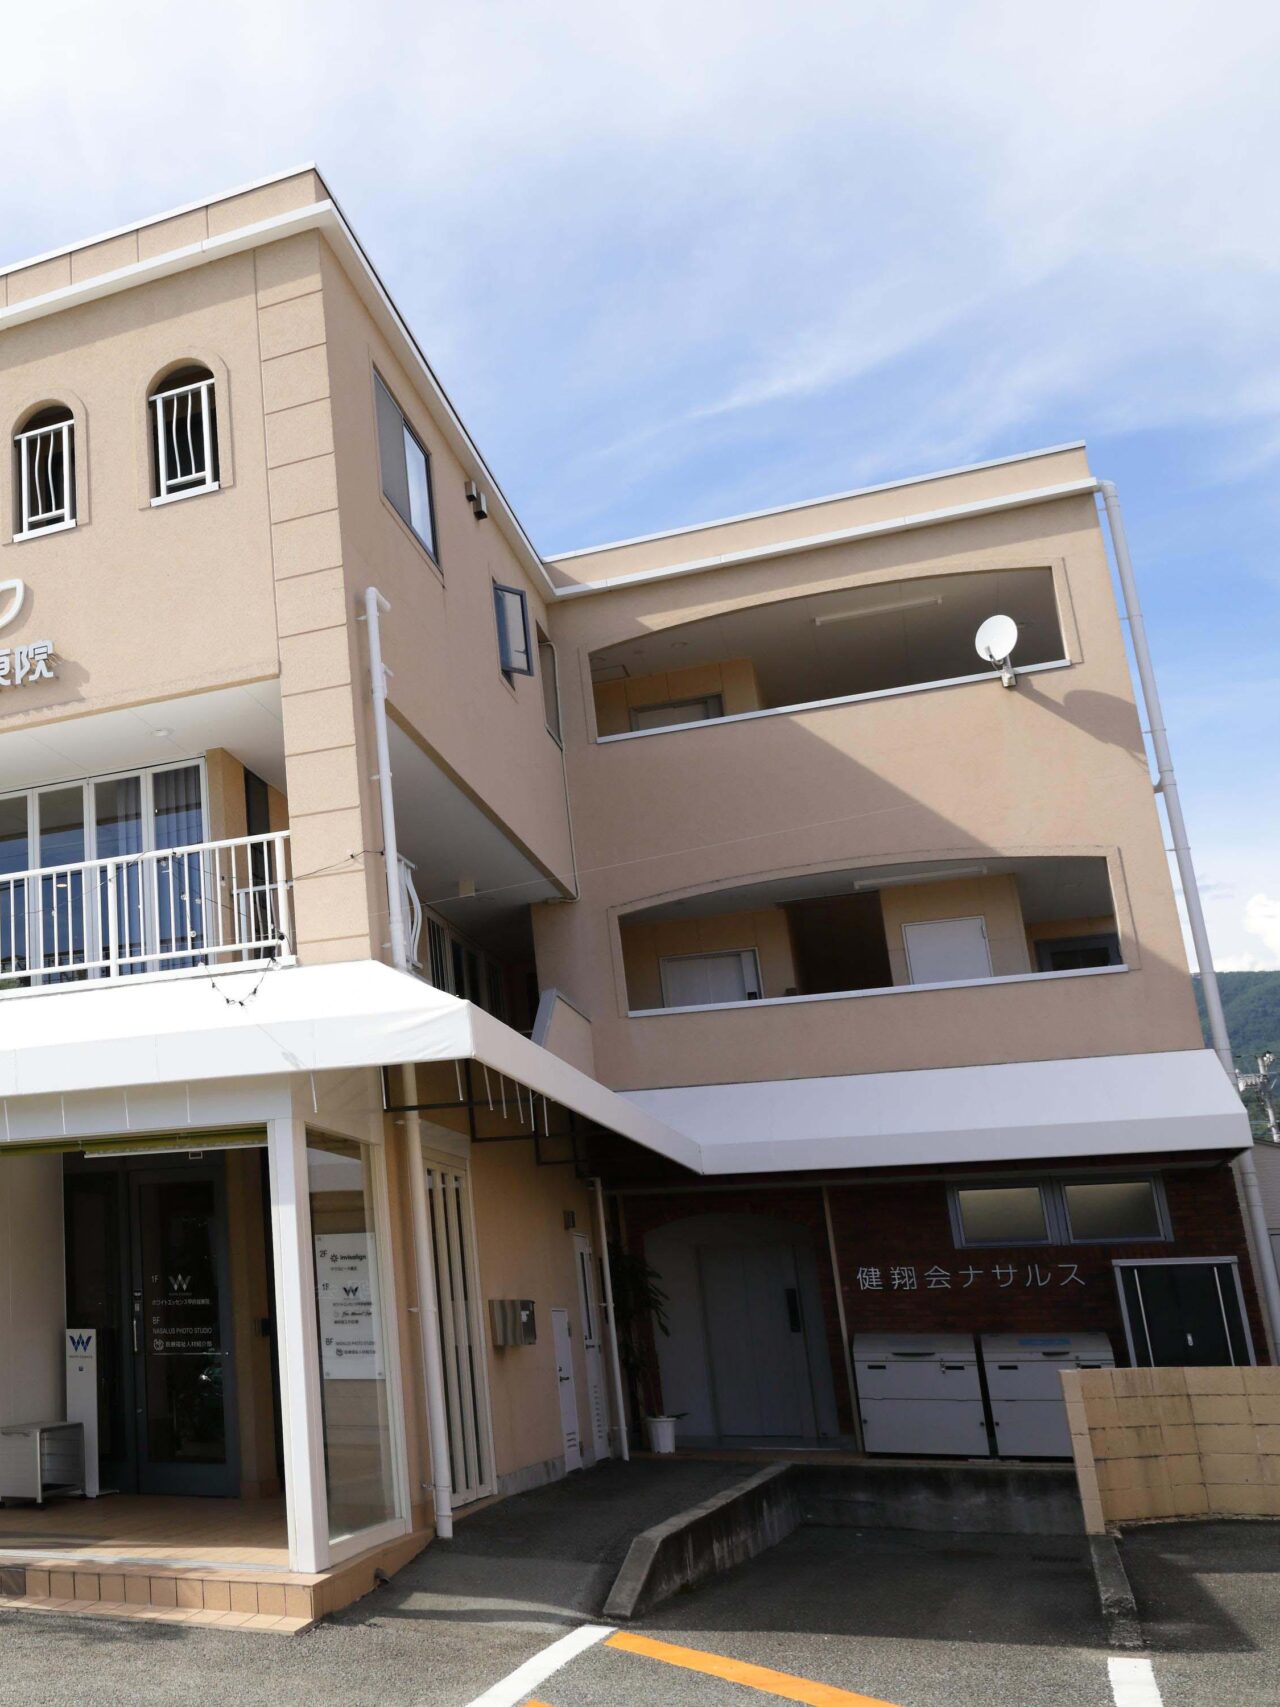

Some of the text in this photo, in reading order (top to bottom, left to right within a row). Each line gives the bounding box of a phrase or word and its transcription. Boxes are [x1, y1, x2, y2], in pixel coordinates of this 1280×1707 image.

[856, 1264, 1086, 1290] 健翔会ナサルス
